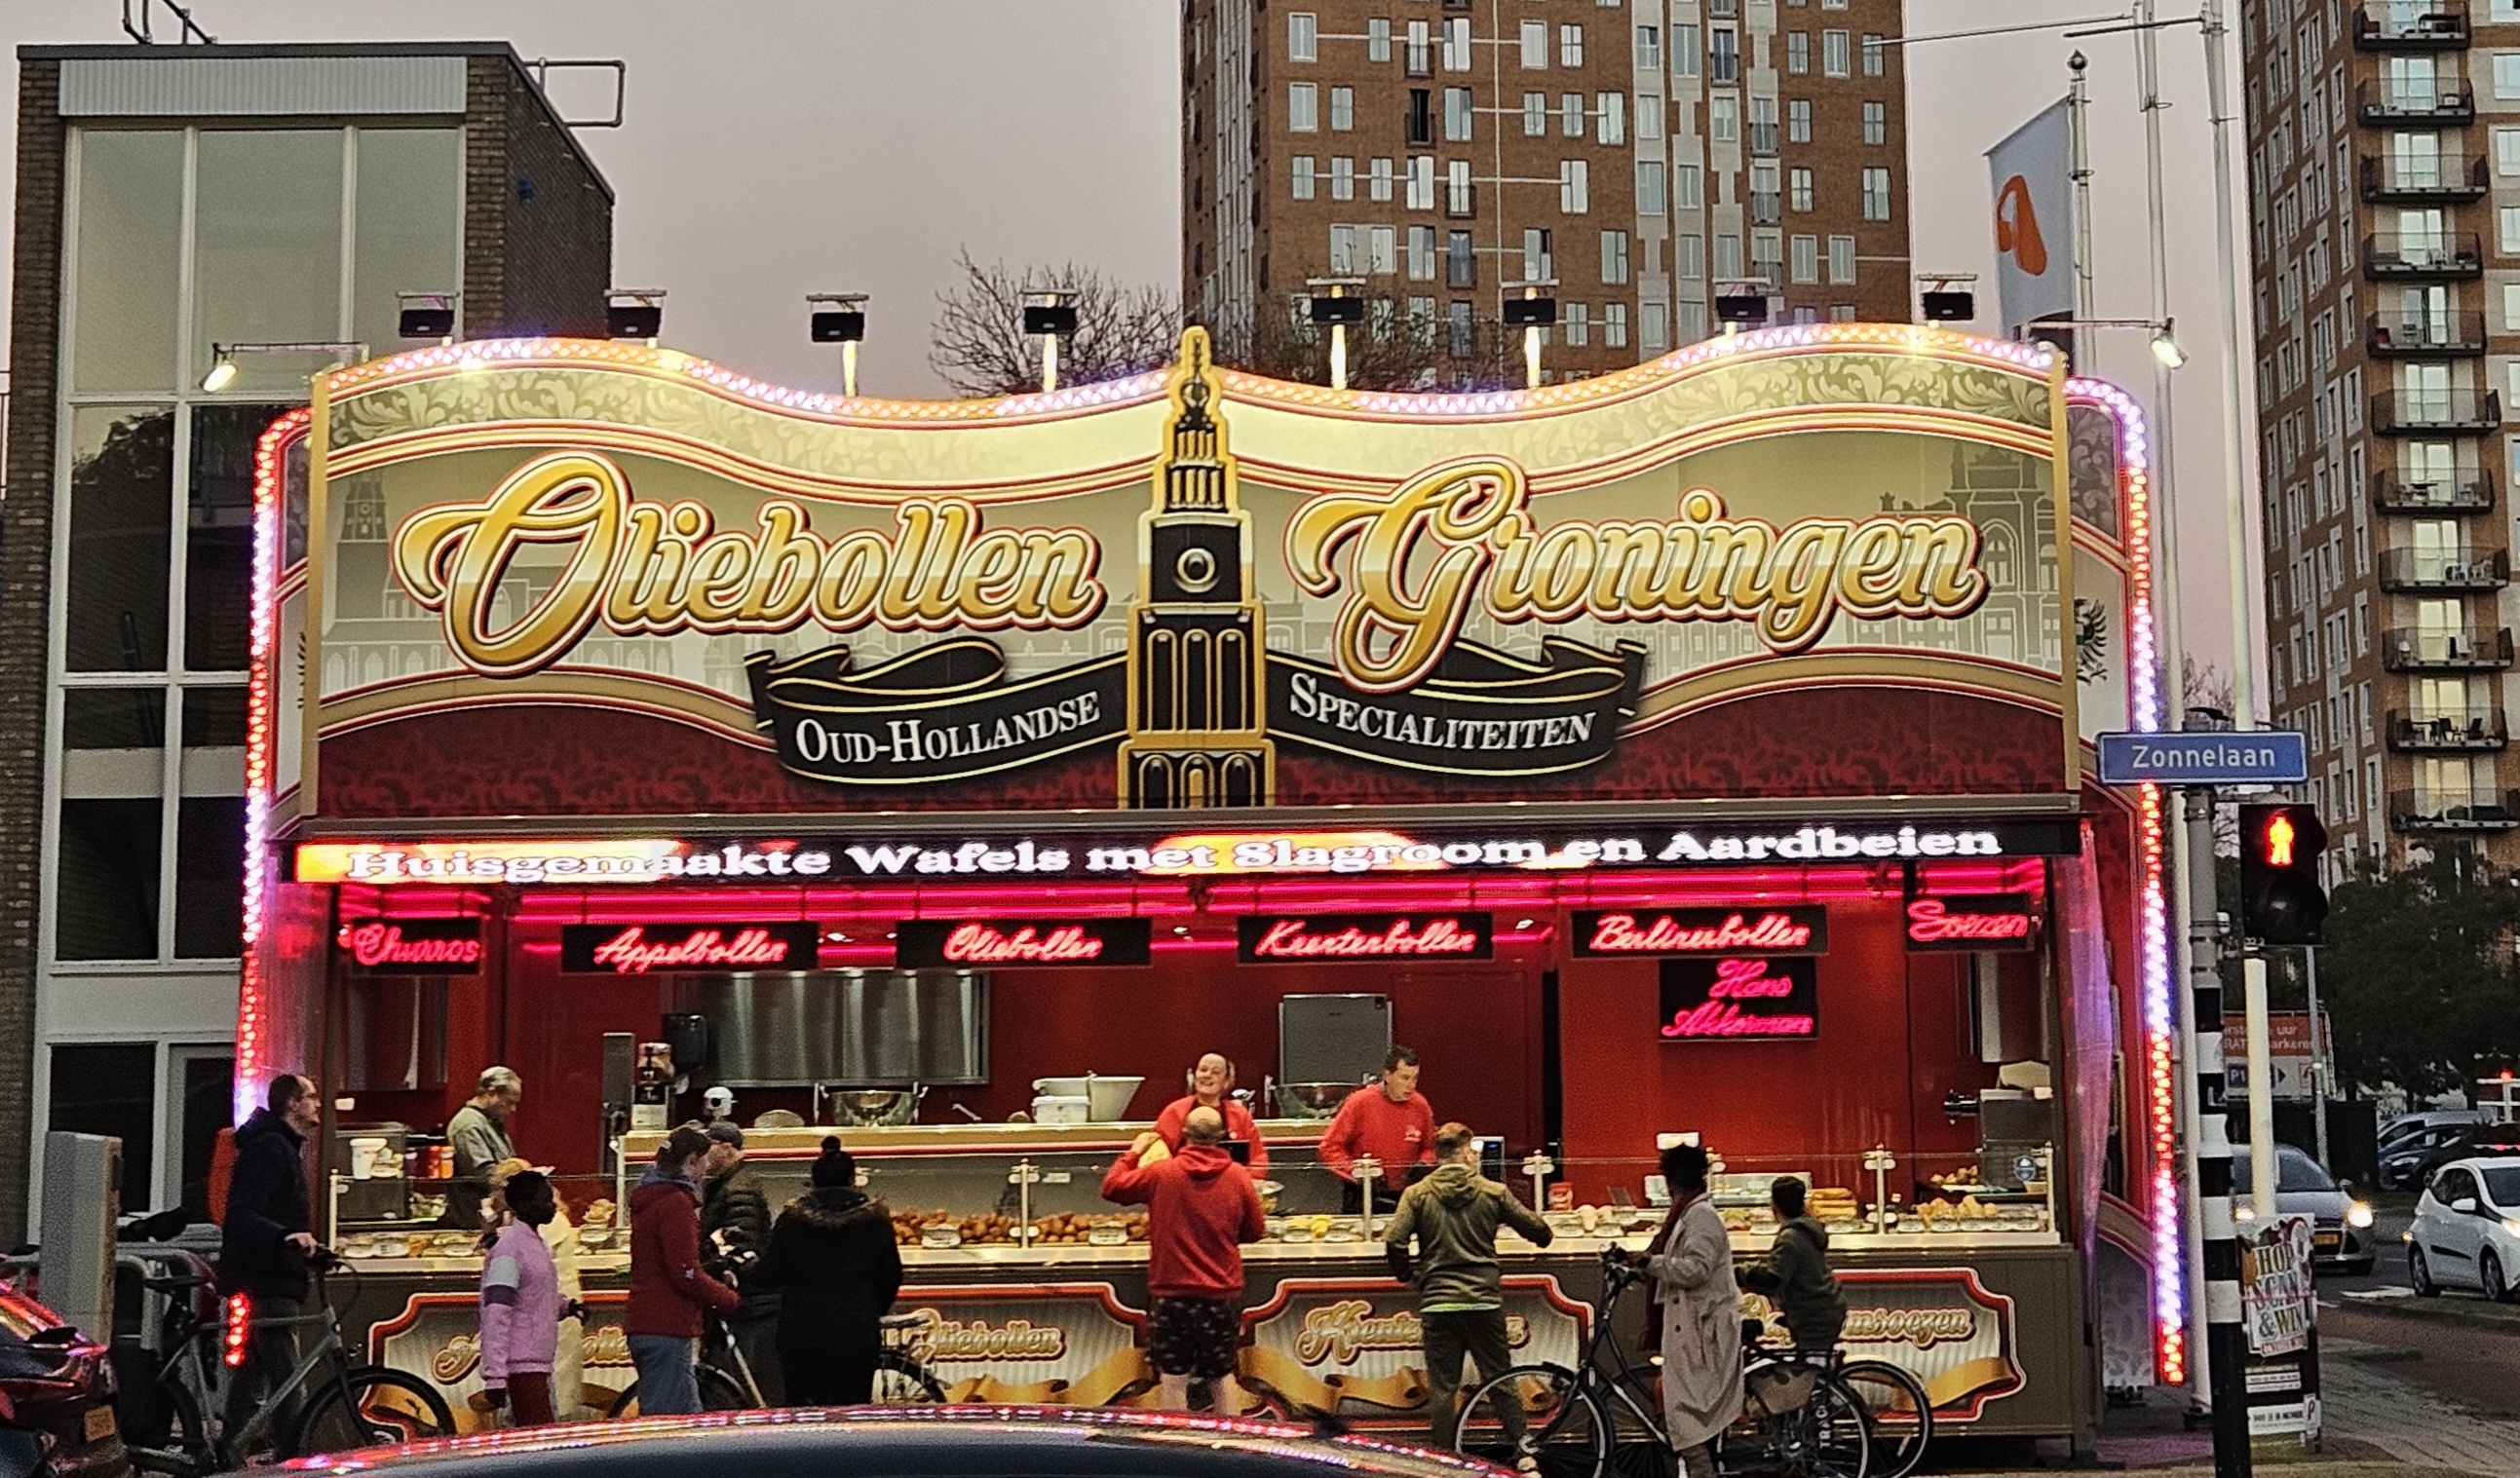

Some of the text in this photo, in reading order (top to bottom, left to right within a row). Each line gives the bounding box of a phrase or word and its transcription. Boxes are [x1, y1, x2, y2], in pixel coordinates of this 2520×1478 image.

[396, 453, 1987, 691] Oliebollen Groningen
[795, 672, 1595, 764] OUD-HOLLANDSE SPECIALITEITEN
[2131, 745, 2275, 769] Zonnelaan
[348, 826, 2003, 883] Huisgemaakte Wafels met Slagroom en Aardbeien
[352, 923, 480, 966] Churros
